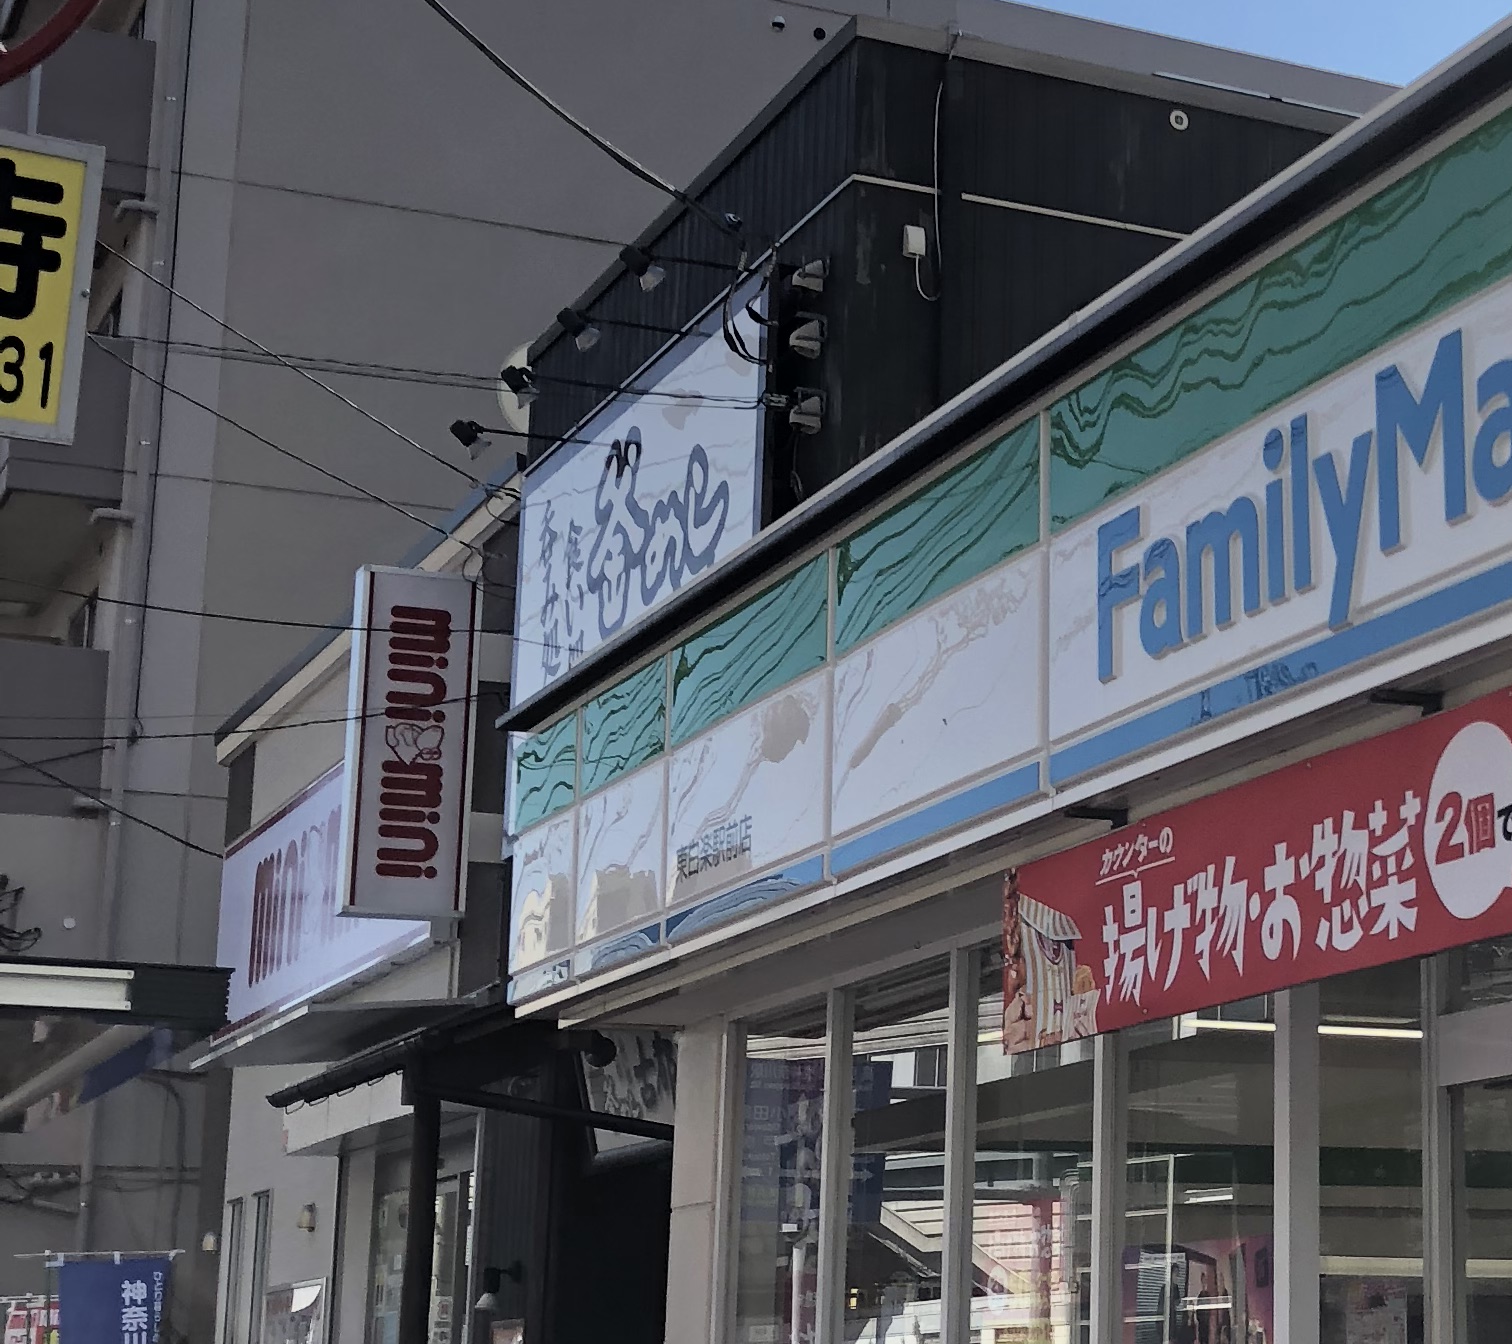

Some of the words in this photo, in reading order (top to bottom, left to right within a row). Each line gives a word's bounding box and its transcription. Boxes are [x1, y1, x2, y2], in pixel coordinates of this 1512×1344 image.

[385, 605, 452, 723] mini
[375, 761, 444, 880] mini
[676, 814, 752, 883] 東白楽駅前店
[1100, 826, 1173, 876] カウンターの
